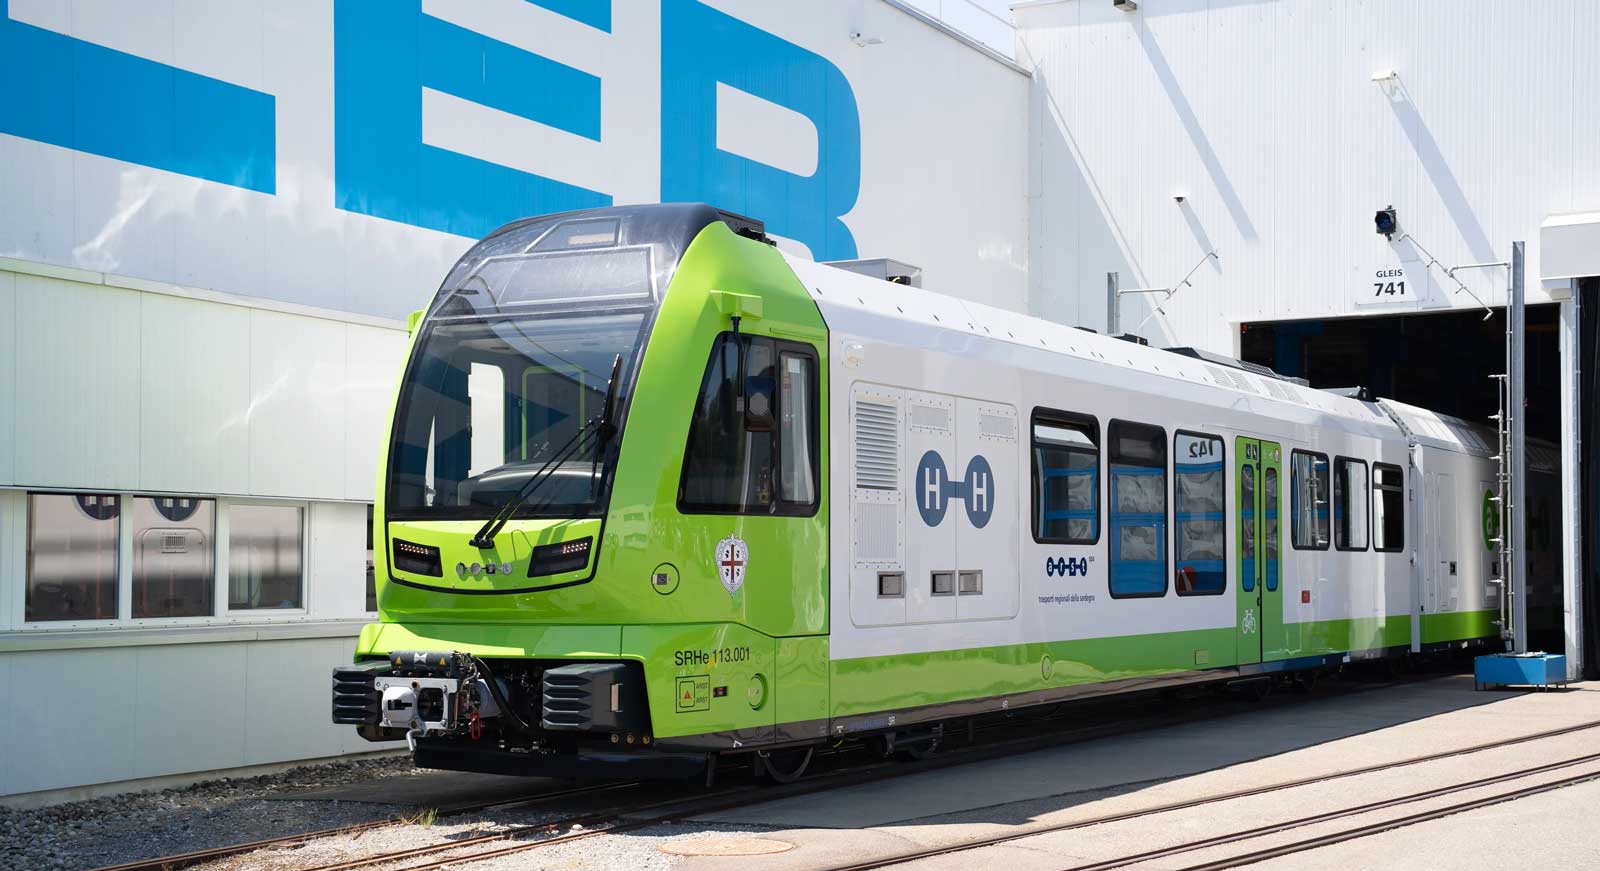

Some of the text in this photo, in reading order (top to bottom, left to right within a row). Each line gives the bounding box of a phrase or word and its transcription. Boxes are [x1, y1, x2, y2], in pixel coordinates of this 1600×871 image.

[1376, 269, 1403, 278] GLEIS
[1373, 281, 1405, 297] 741
[674, 647, 750, 666] SRHe 113.001
